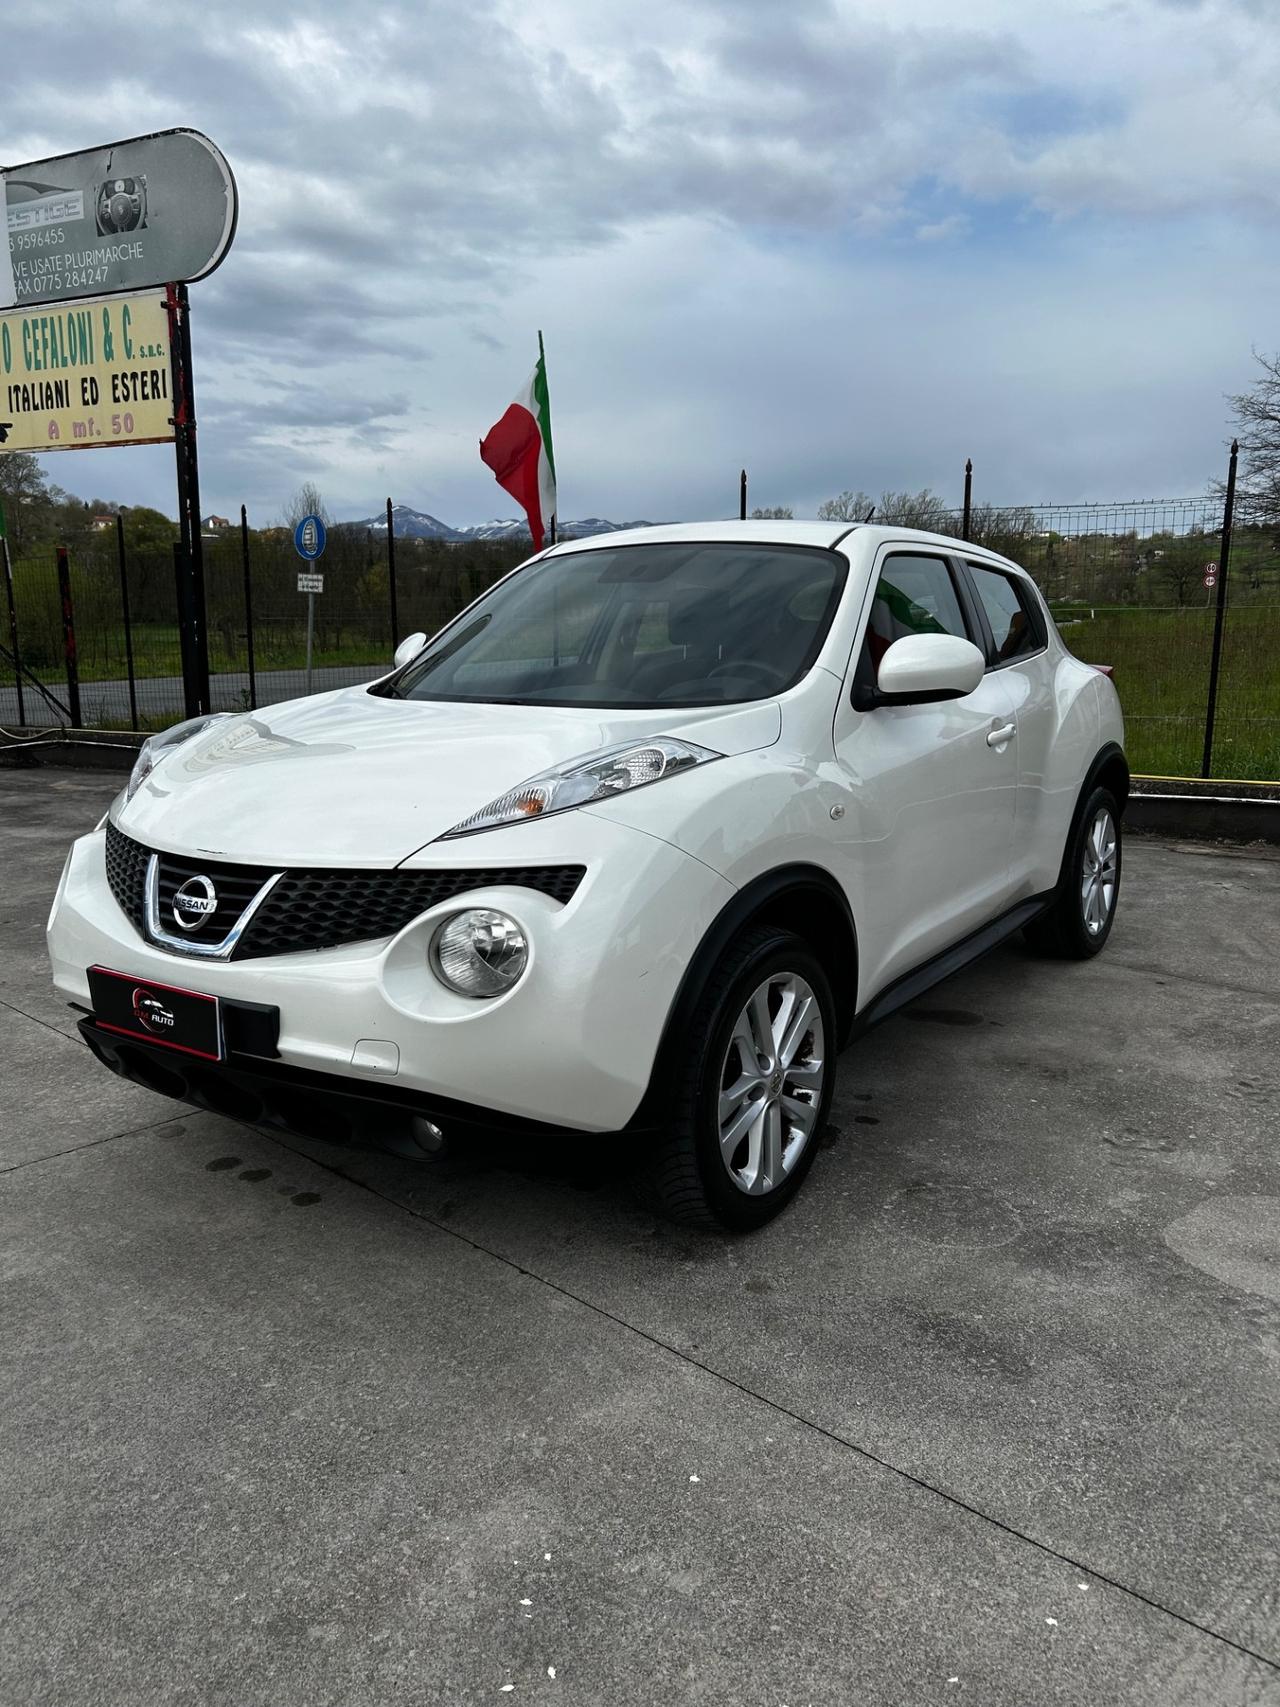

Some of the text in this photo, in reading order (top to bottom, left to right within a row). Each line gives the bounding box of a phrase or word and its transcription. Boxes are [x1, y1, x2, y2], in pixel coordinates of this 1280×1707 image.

[18, 228, 65, 251] 9596455
[30, 255, 62, 274] USATE
[65, 242, 144, 270] PLURIMARCHE
[33, 273, 62, 293] 0775
[65, 266, 109, 288] 284247
[22, 311, 94, 371] CEFALONI
[103, 307, 114, 362] &
[8, 369, 167, 413] ITALIANI ED ESTERI
[48, 419, 60, 440] A
[112, 413, 134, 434] 50
[174, 897, 209, 910] NISSAN
[151, 1014, 174, 1026] AUTO
